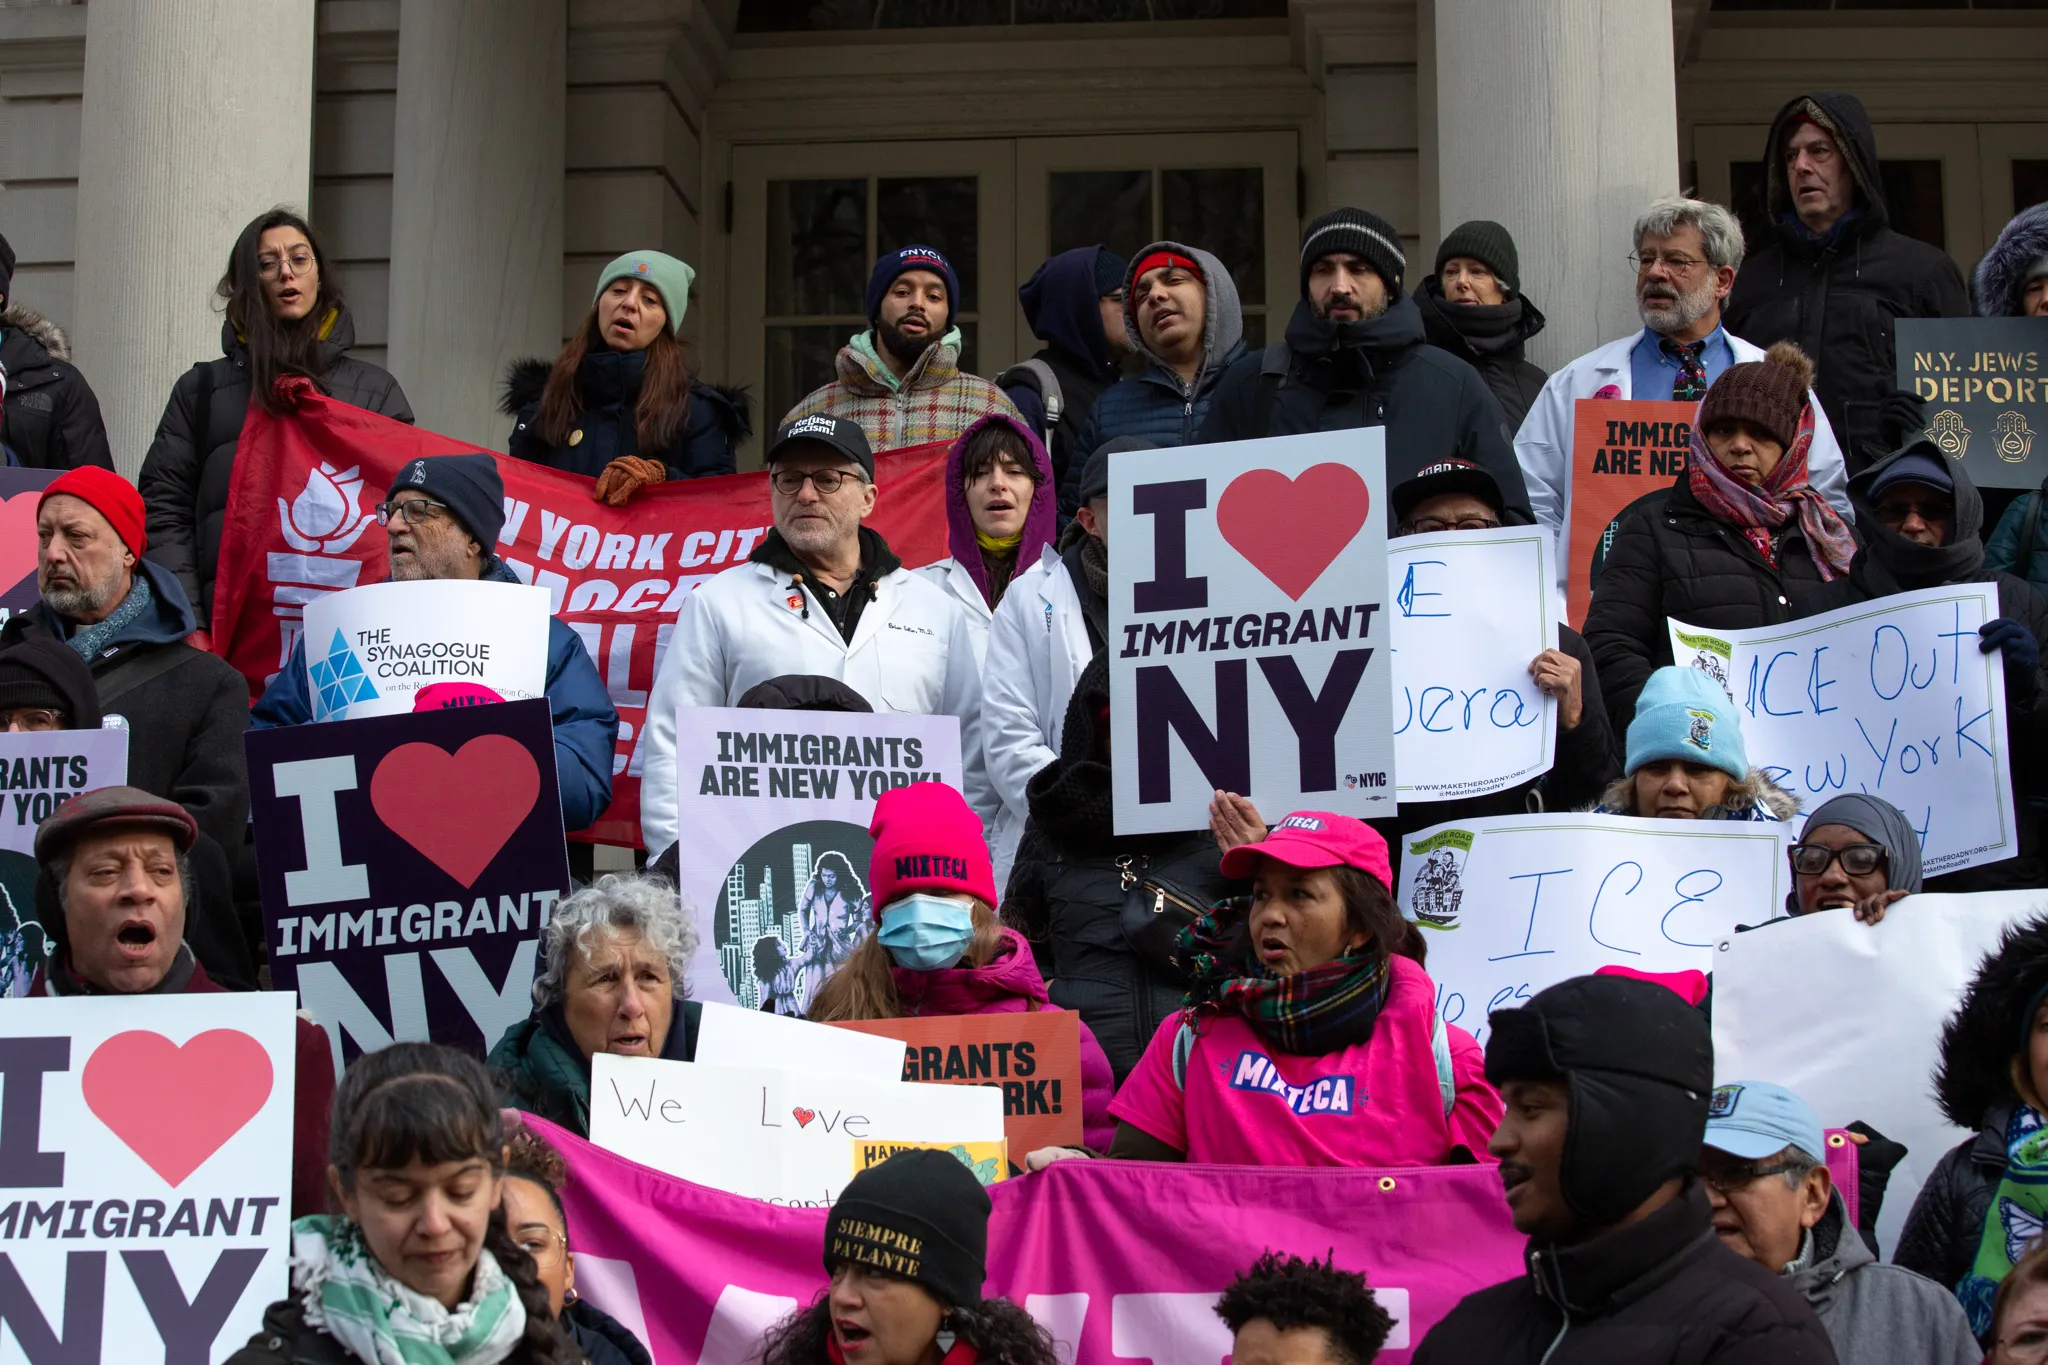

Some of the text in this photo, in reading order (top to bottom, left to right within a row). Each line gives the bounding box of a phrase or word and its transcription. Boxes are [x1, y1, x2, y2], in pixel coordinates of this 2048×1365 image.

[1915, 352, 2038, 371] N.Y. JEWS
[787, 420, 836, 438] Fascism!
[794, 414, 832, 428] Refuse
[1592, 449, 1642, 475] ARE
[537, 508, 673, 570] YORK
[678, 526, 776, 568] CIT
[1133, 478, 1208, 614] I
[357, 628, 391, 646] THE
[1119, 602, 1380, 659] IMMIGRANT
[1710, 638, 1730, 651] ROAD
[367, 642, 490, 662] SYNAGOGUE
[377, 660, 484, 678] COALITION
[1745, 646, 1838, 717] ICE
[385, 684, 397, 692] on
[398, 681, 412, 691] the
[1136, 648, 1375, 805] NY
[717, 731, 923, 768] IMMIGRANTS
[1855, 696, 1993, 789] York
[699, 765, 760, 797] ARE
[769, 768, 839, 799] NEW
[1359, 772, 1387, 788] NYIC
[1414, 769, 1526, 791] WWW.MAKETHEROADNY.ORG
[1439, 782, 1496, 797] @MaketheRoadNY
[272, 755, 370, 907] I
[1415, 831, 1472, 849] MAKE THE ROAD
[1453, 839, 1469, 848] YORK
[894, 855, 967, 880] MIXTECA
[276, 889, 560, 956] IMMIGRANT
[1488, 861, 1722, 961] ICE
[296, 939, 539, 1089] NY
[610, 1078, 686, 1124] We
[838, 1218, 923, 1256] SIEMPRE
[833, 1237, 921, 1277] PA'LANTE
